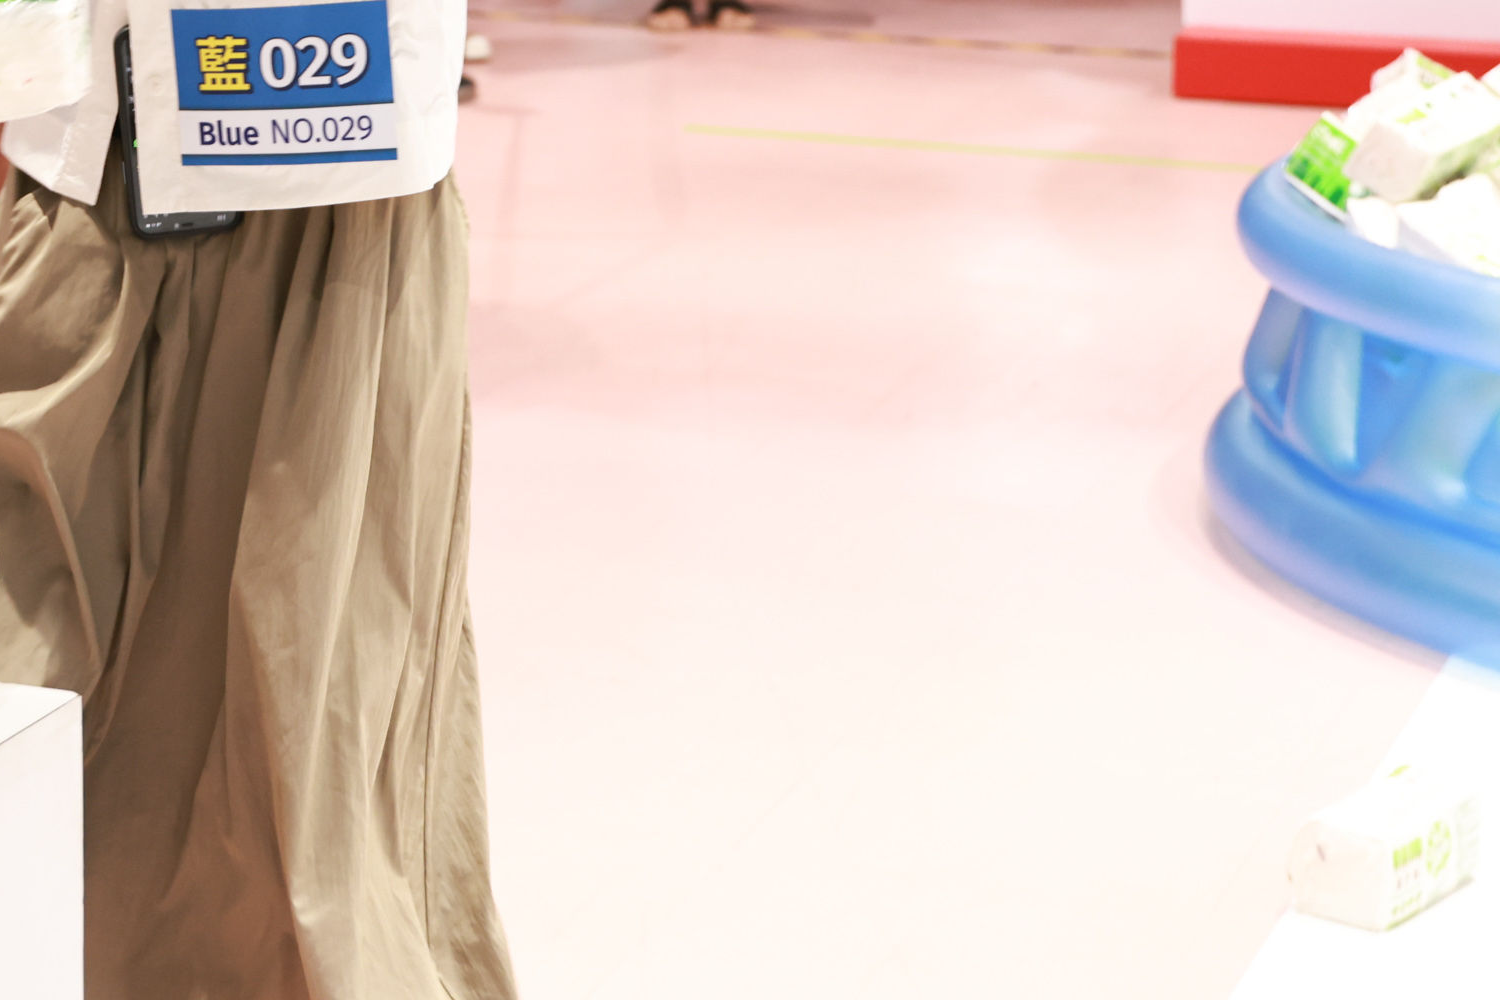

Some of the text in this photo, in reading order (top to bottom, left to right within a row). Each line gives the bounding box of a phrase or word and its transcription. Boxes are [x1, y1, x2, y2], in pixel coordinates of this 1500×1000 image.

[196, 33, 369, 92] 藍 029
[199, 115, 373, 146] Blue NO.029
